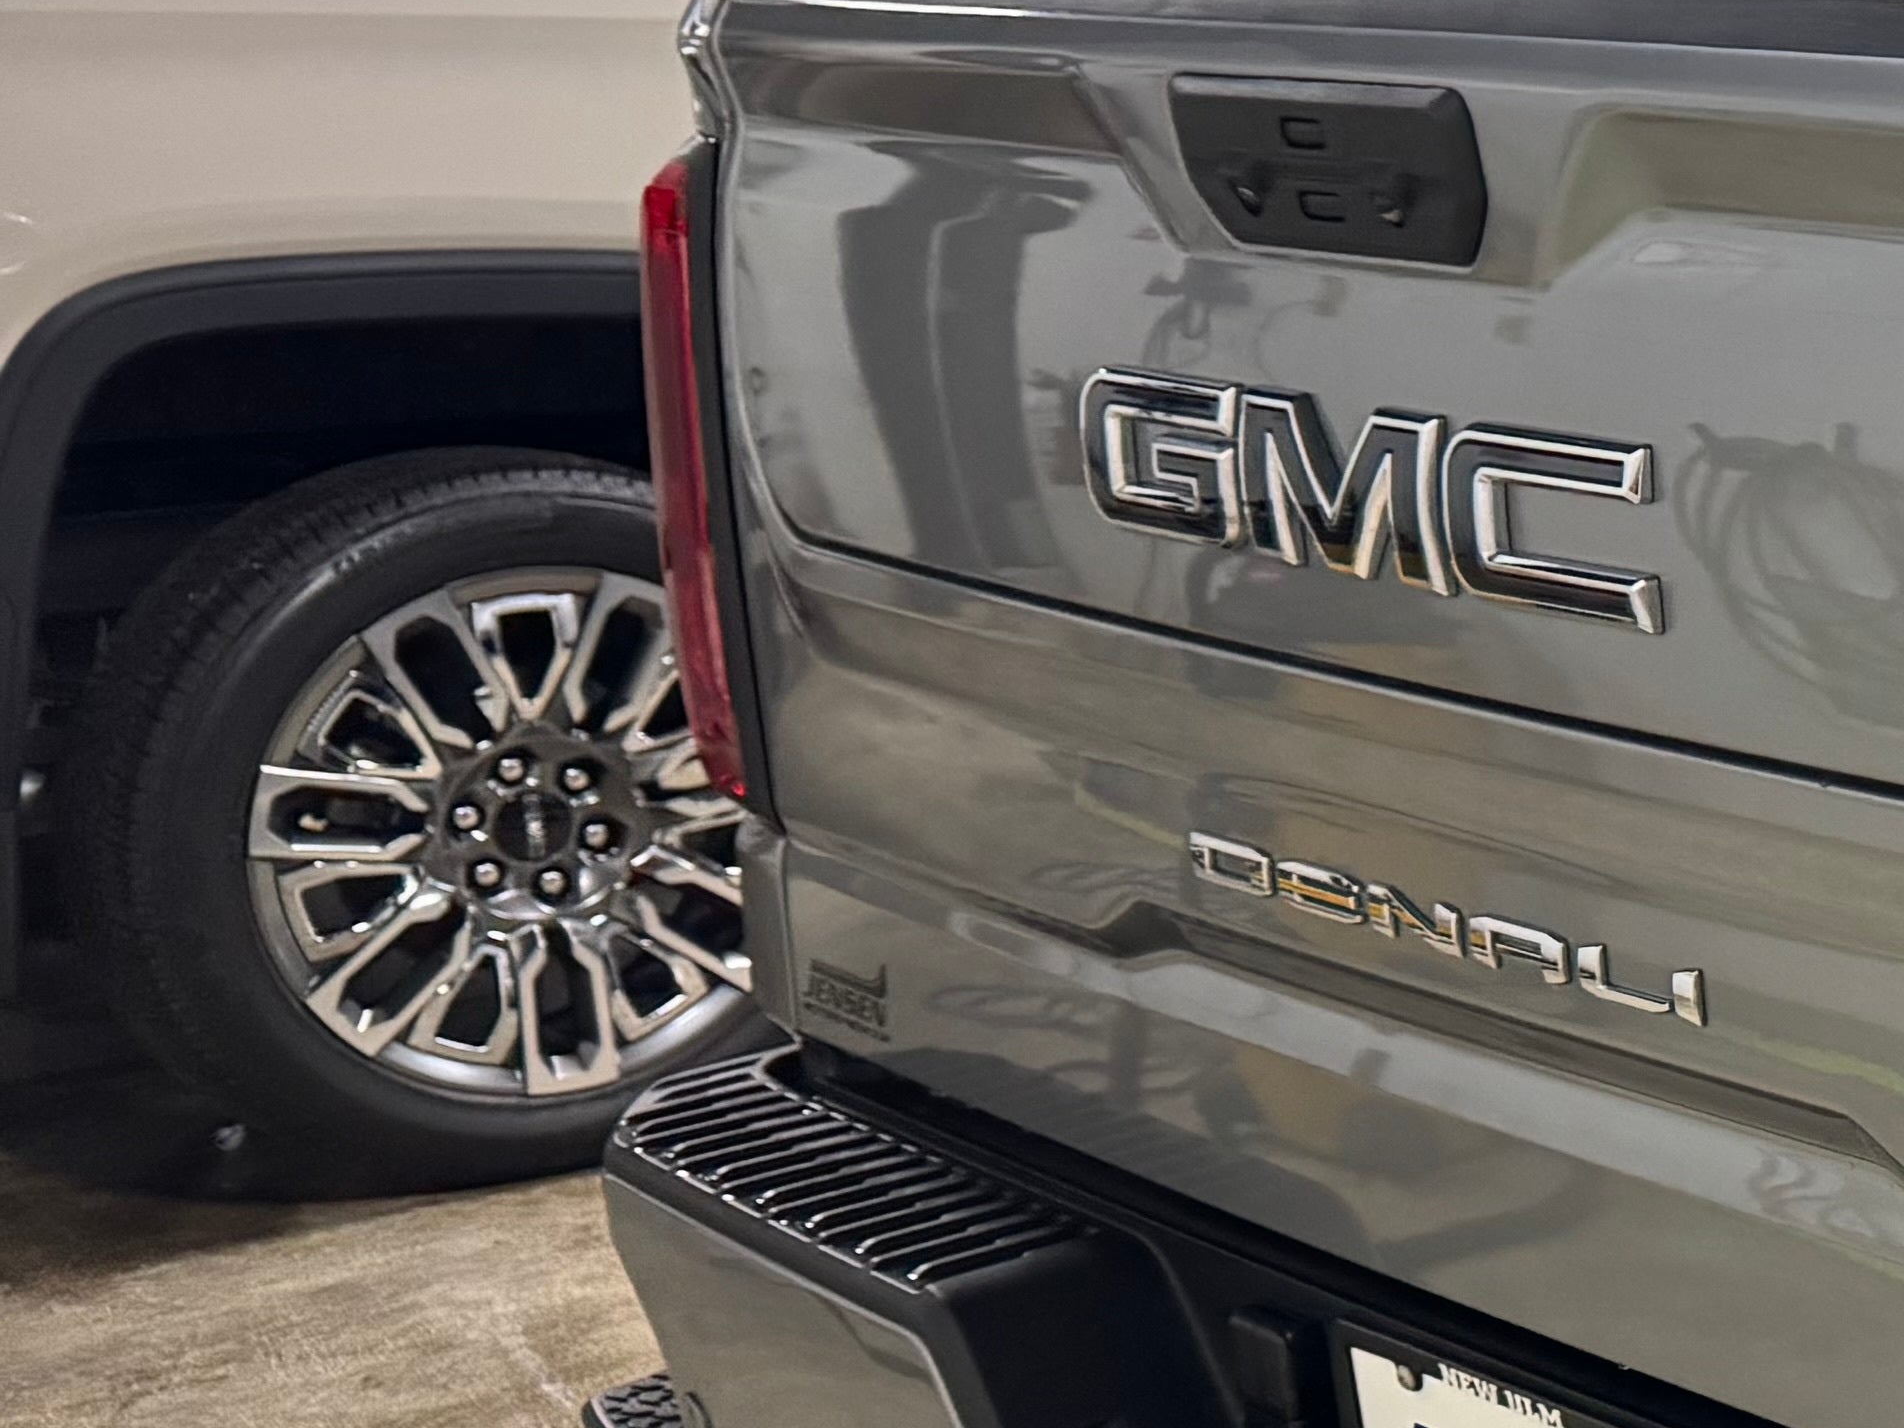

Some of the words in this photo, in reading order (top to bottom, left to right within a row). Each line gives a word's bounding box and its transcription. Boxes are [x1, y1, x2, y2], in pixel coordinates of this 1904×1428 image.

[1080, 365, 1667, 636] GMC
[1189, 830, 1706, 1026] DENALI
[1437, 1360, 1499, 1406] NEW
